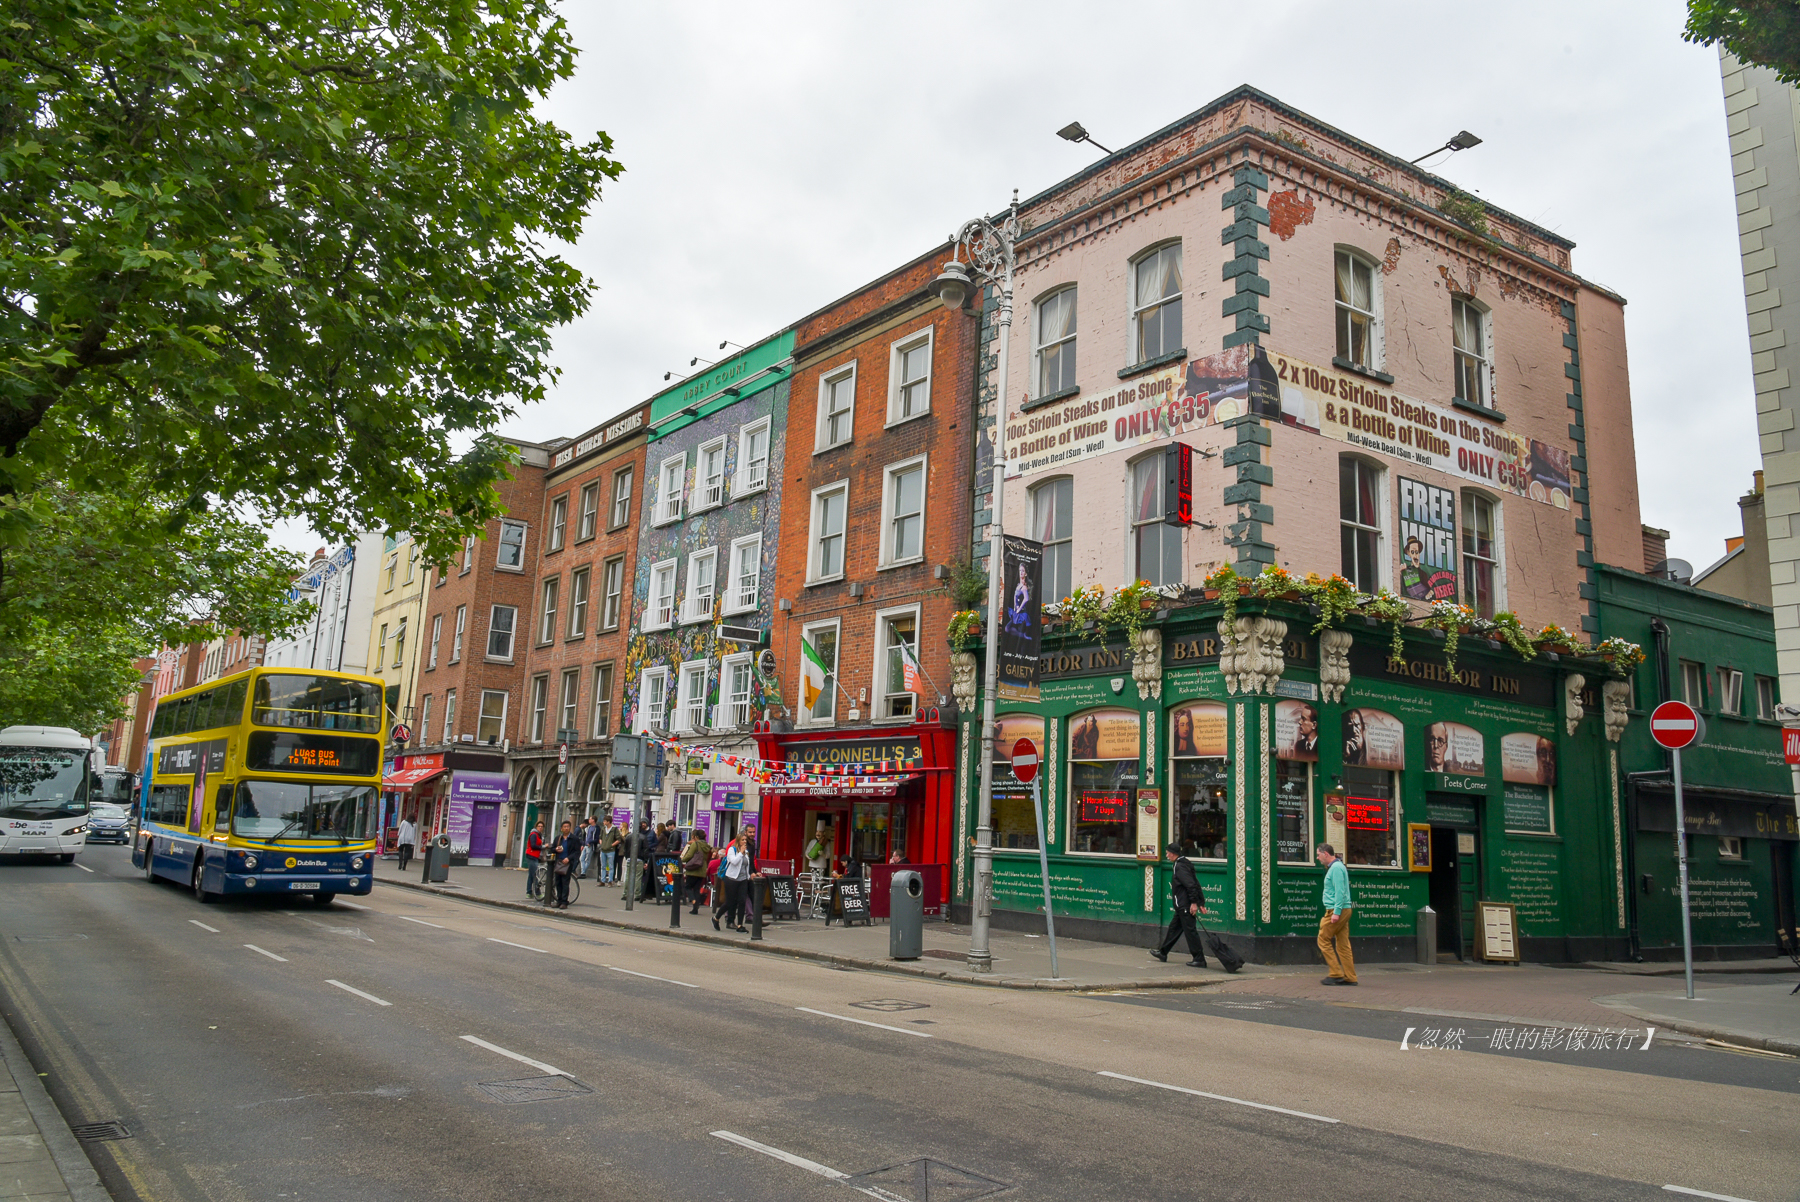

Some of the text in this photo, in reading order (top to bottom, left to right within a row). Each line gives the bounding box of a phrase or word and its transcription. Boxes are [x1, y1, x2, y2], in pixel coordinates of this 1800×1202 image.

[683, 361, 748, 401] ABBEY COURT
[1006, 423, 1027, 441] 10oz
[1028, 411, 1062, 435] Sirloin
[1063, 400, 1099, 423] Steaks
[1101, 395, 1115, 412] on
[1117, 388, 1136, 407] the
[1138, 377, 1172, 400] Stone
[1278, 357, 1518, 457] 2 x 10oz Sirloin Steaks on the Stone
[1114, 390, 1211, 443] ONLY €35
[605, 410, 643, 443] MISSIONS
[1325, 401, 1450, 458] & a Bottle of Wine
[1010, 419, 1108, 460] a Bottle of Wine
[1347, 431, 1381, 450] Mid-Week
[1381, 441, 1396, 455] Deal
[1018, 454, 1049, 472] Mid-Week
[1050, 450, 1065, 462] Deal
[1457, 446, 1528, 491] ONLY €35
[1400, 478, 1453, 531] FREE
[1427, 571, 1456, 588] AVAILABLE
[1433, 582, 1456, 599] HERE!
[1171, 638, 1217, 660] BAR
[1287, 640, 1307, 660] 31
[1088, 649, 1122, 669] INN
[1005, 663, 1035, 678] GAIETY
[1386, 655, 1520, 695] BACHELOR INN
[288, 755, 340, 766] To The Point
[294, 748, 335, 758] LUAS BUS
[787, 751, 799, 762] 30
[804, 745, 905, 763] O'CONNELL'S
[809, 787, 838, 795] O'CONNELL'S
[1444, 775, 1487, 790] Poets Corner
[1086, 796, 1124, 806] Horse Racing
[1514, 792, 1534, 800] Bachelor
[1094, 805, 1115, 815] 7 Days
[1756, 811, 1779, 833] The
[1287, 840, 1304, 848] SERVED
[761, 866, 780, 875] O'CONNELL'S
[773, 881, 789, 890] LIVE
[773, 889, 793, 898] MUSIC
[840, 884, 860, 895] FREE
[1359, 891, 1368, 899] Her
[1381, 891, 1389, 899] that
[844, 899, 863, 909] BEER
